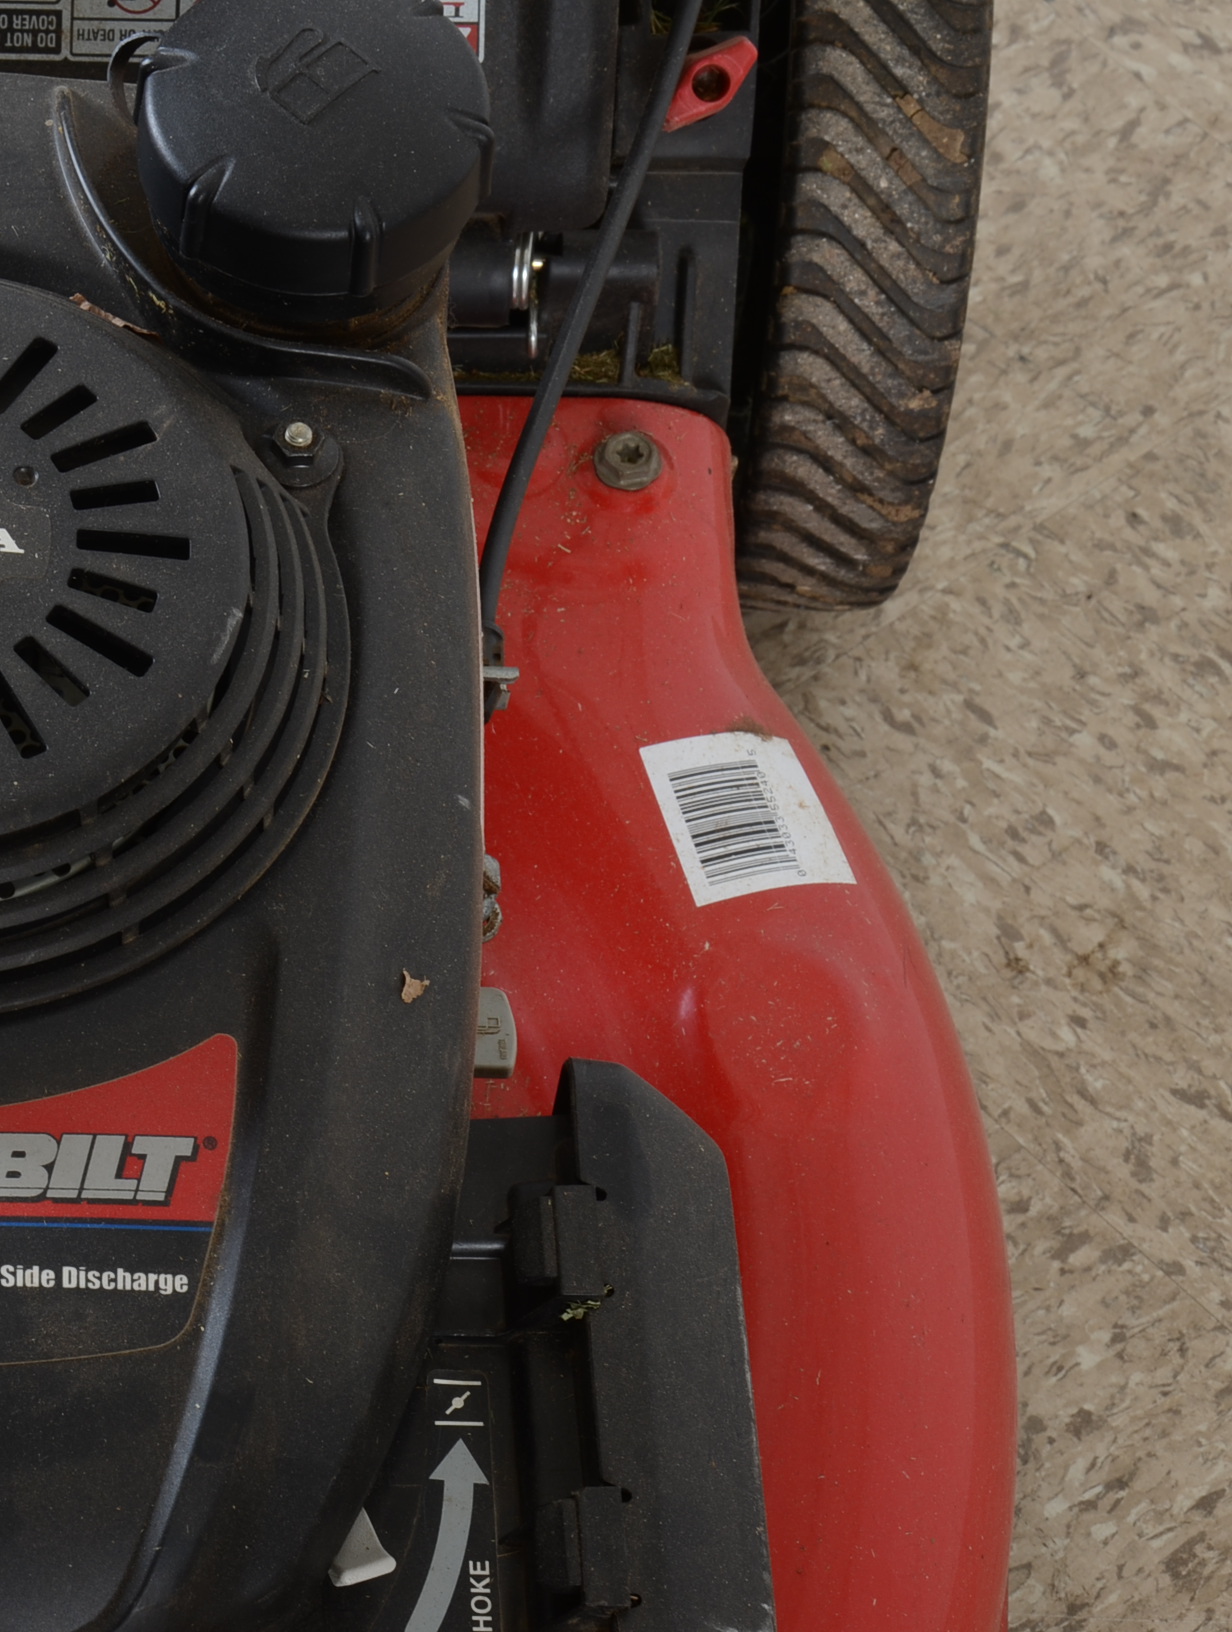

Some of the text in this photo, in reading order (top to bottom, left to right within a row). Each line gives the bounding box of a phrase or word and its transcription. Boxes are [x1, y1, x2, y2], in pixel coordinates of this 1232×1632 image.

[12, 15, 57, 30] COVER
[4, 32, 32, 47] NOT
[37, 33, 56, 47] DO
[77, 28, 115, 41] DEATH
[0, 1265, 55, 1289] Side
[61, 1265, 189, 1295] Discharge
